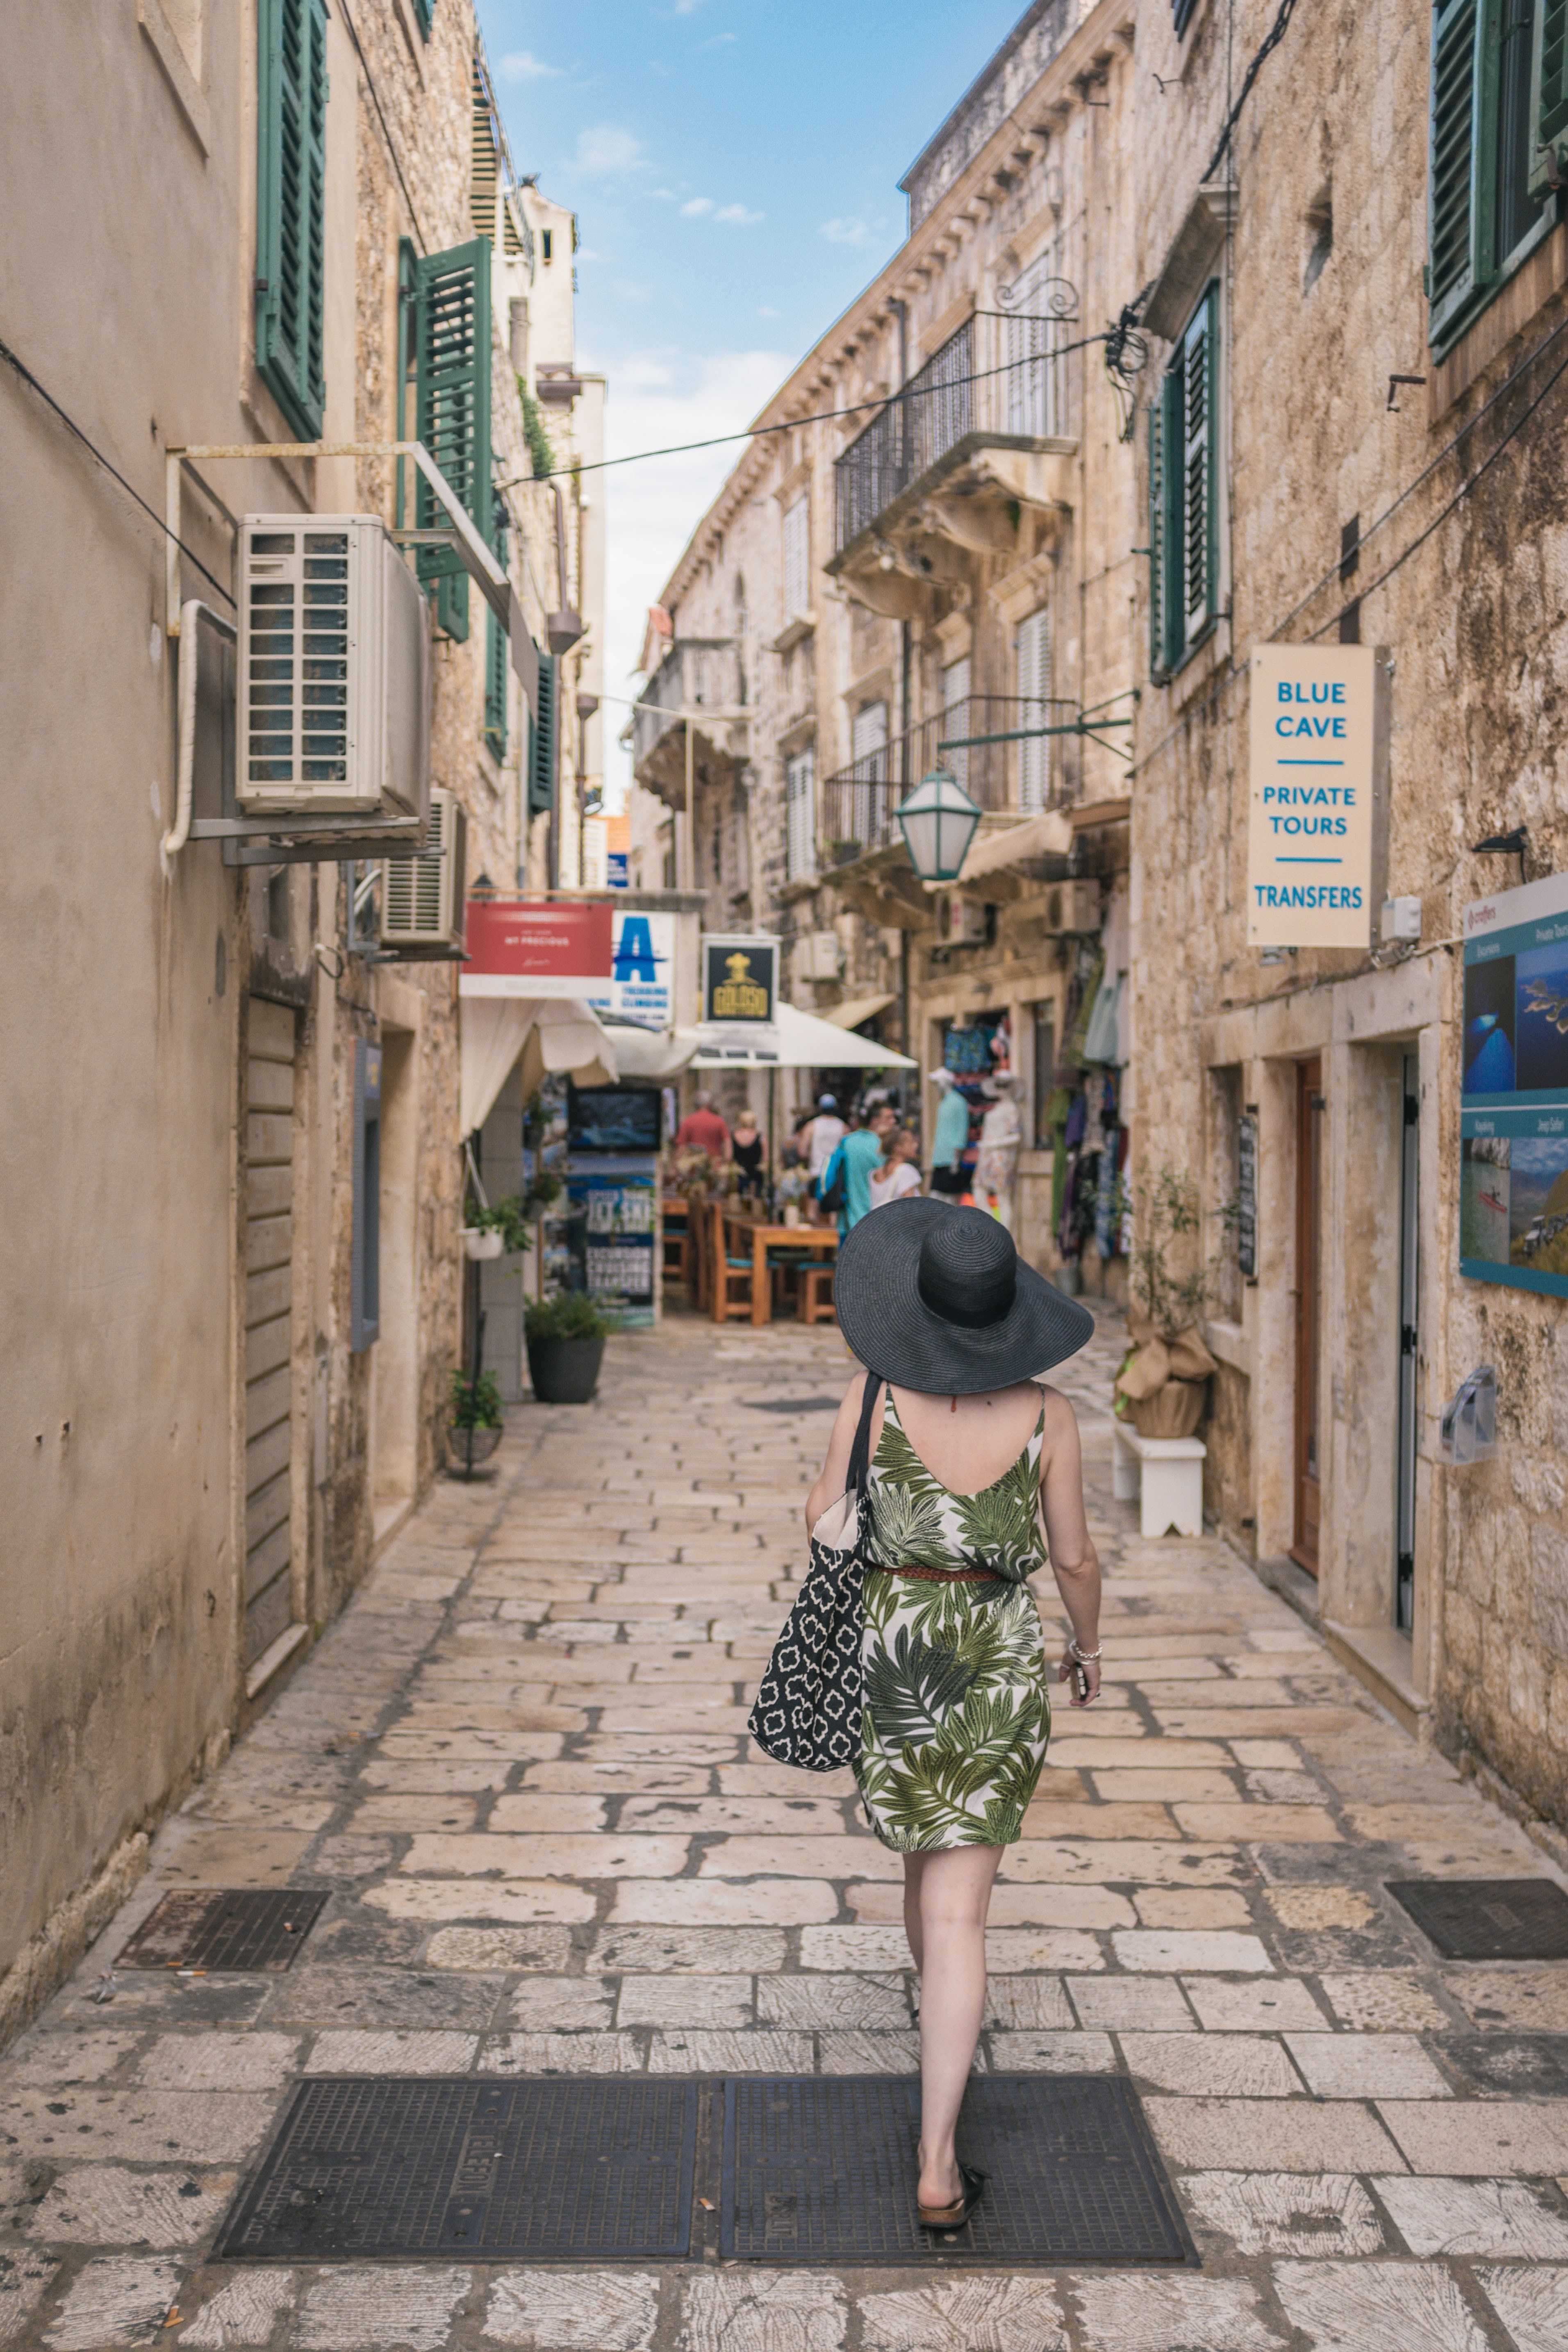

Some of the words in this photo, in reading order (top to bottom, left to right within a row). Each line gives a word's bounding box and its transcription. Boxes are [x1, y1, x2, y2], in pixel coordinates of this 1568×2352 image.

[1278, 682, 1345, 704] BLUE
[1275, 716, 1346, 738] CAVE
[1264, 786, 1355, 806] PRIVATE
[1269, 816, 1347, 836] TOURS
[1254, 885, 1362, 909] TRANSFERS
[504, 936, 519, 946] MY
[520, 936, 570, 947] PRECIOUS
[622, 986, 668, 995] TREKKING
[713, 984, 768, 1018] GOLOSO
[621, 998, 668, 1009] CLIMBING
[456, 2130, 496, 2193] TELEFON
